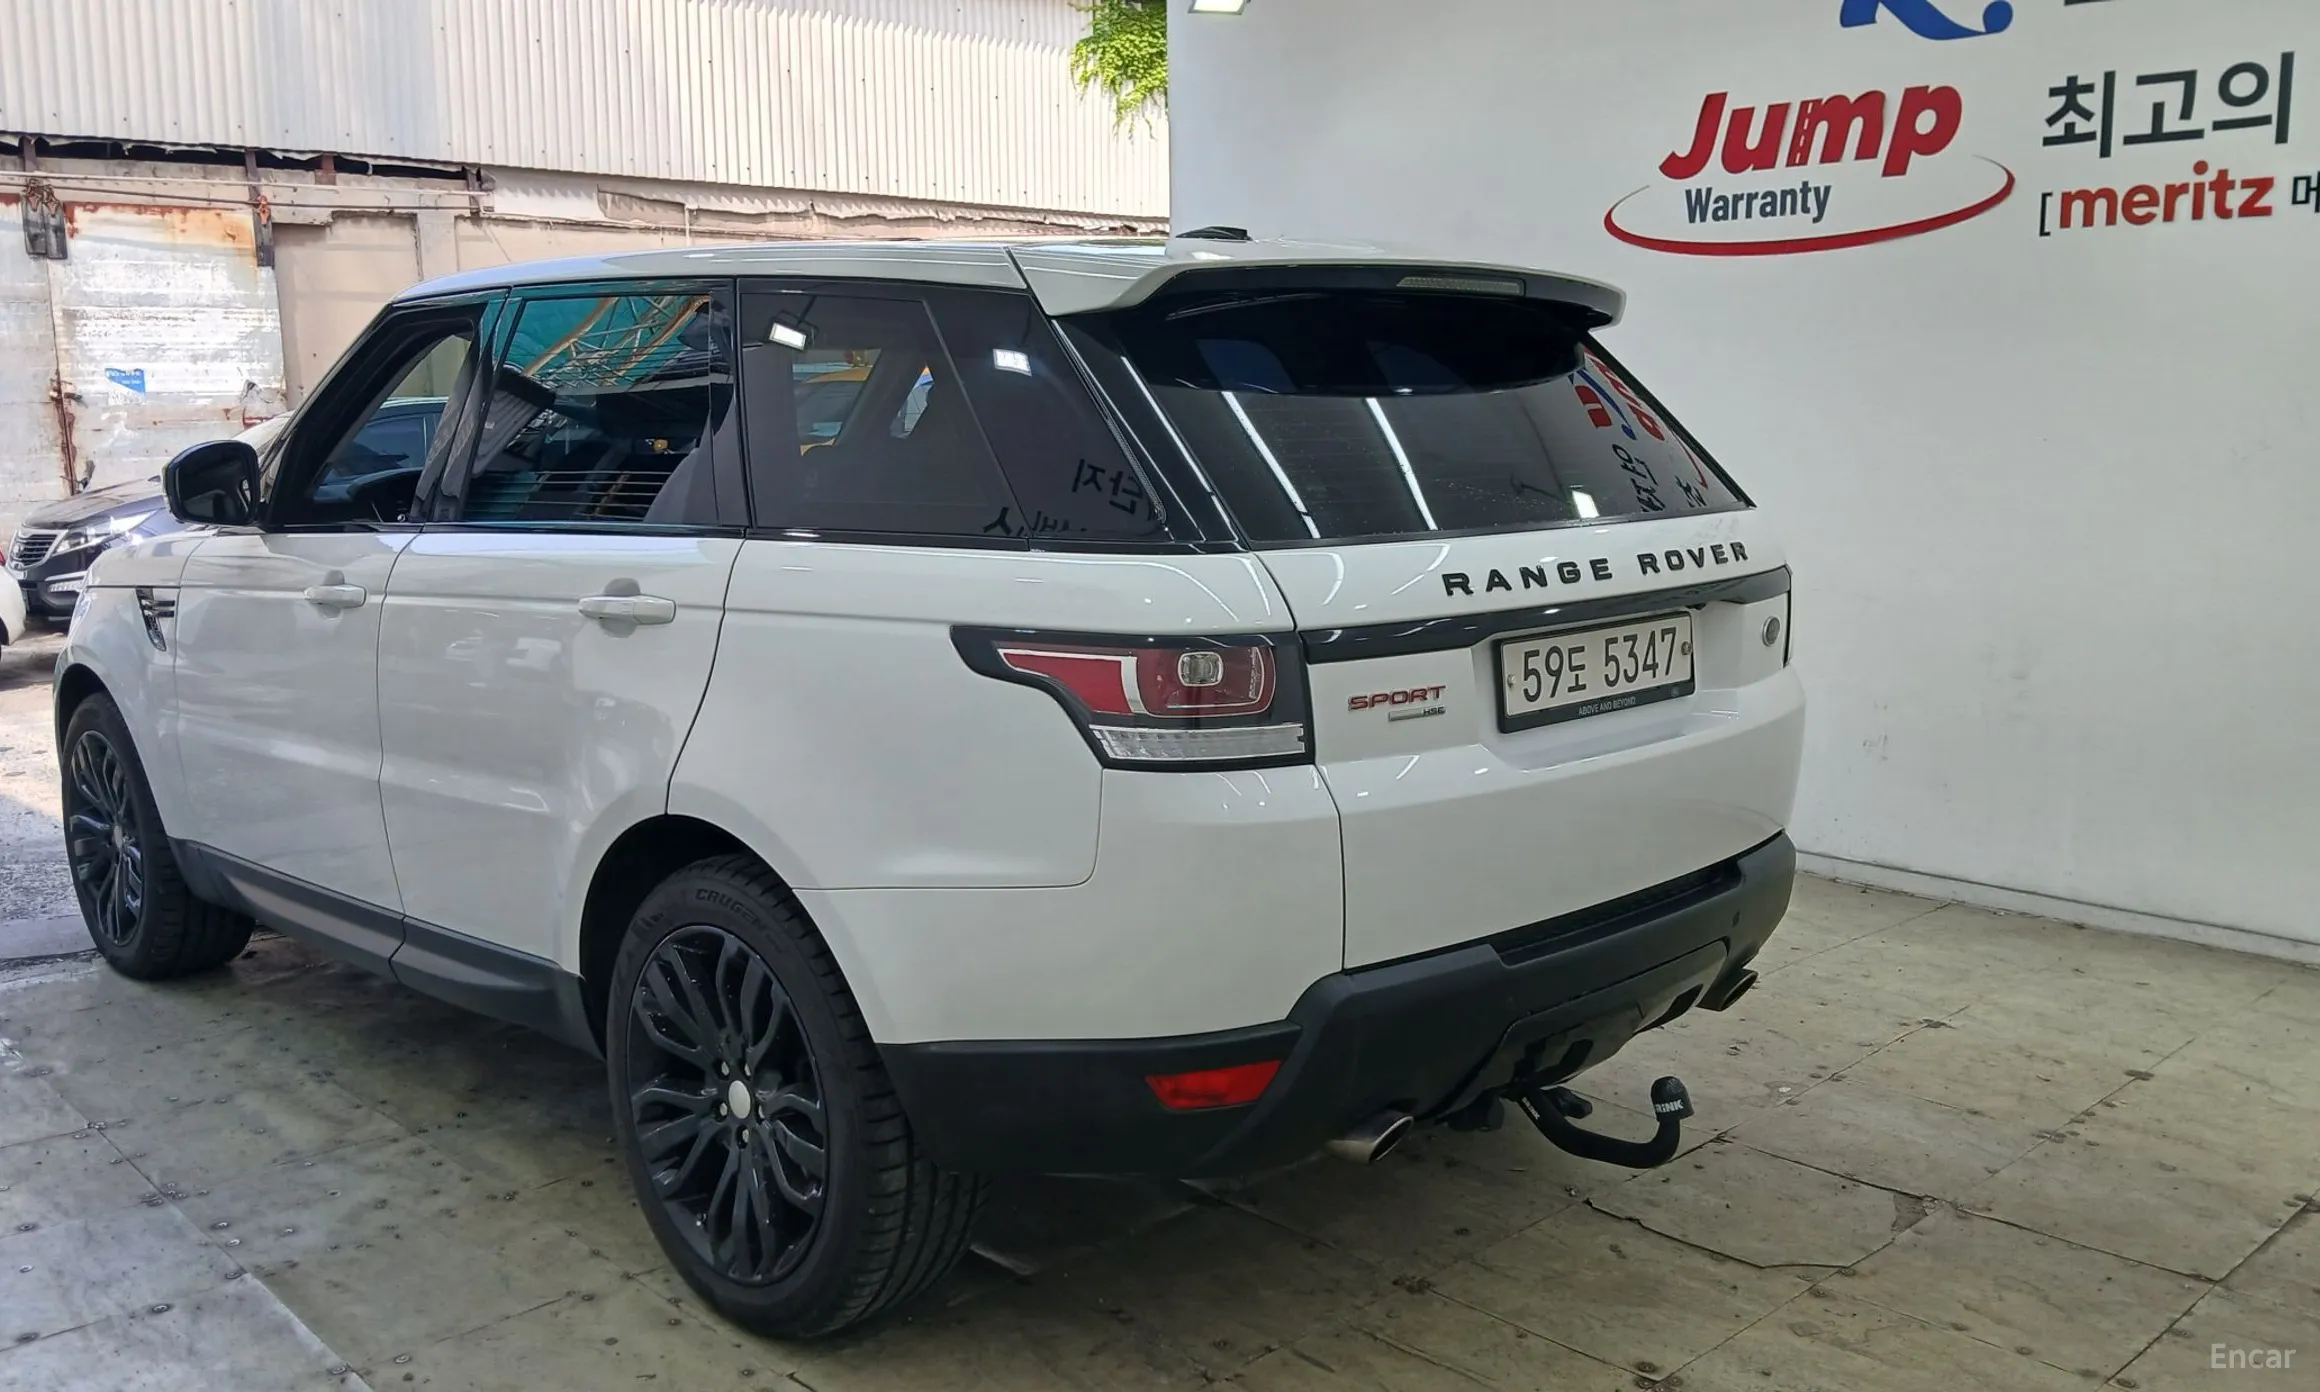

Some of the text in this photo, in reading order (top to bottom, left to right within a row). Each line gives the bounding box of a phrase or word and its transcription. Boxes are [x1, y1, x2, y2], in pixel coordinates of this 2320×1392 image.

[2042, 51, 2295, 158] 최고의
[1658, 84, 1963, 180] Jump
[1685, 180, 1832, 224] Warranty
[1441, 541, 1749, 597] RANGE ROVER
[1523, 626, 1677, 703] 59도 5347
[1348, 684, 1447, 711] SPORT
[1423, 706, 1445, 717] HSE
[1578, 704, 1600, 716] ABOVE
[1600, 702, 1612, 712] AND
